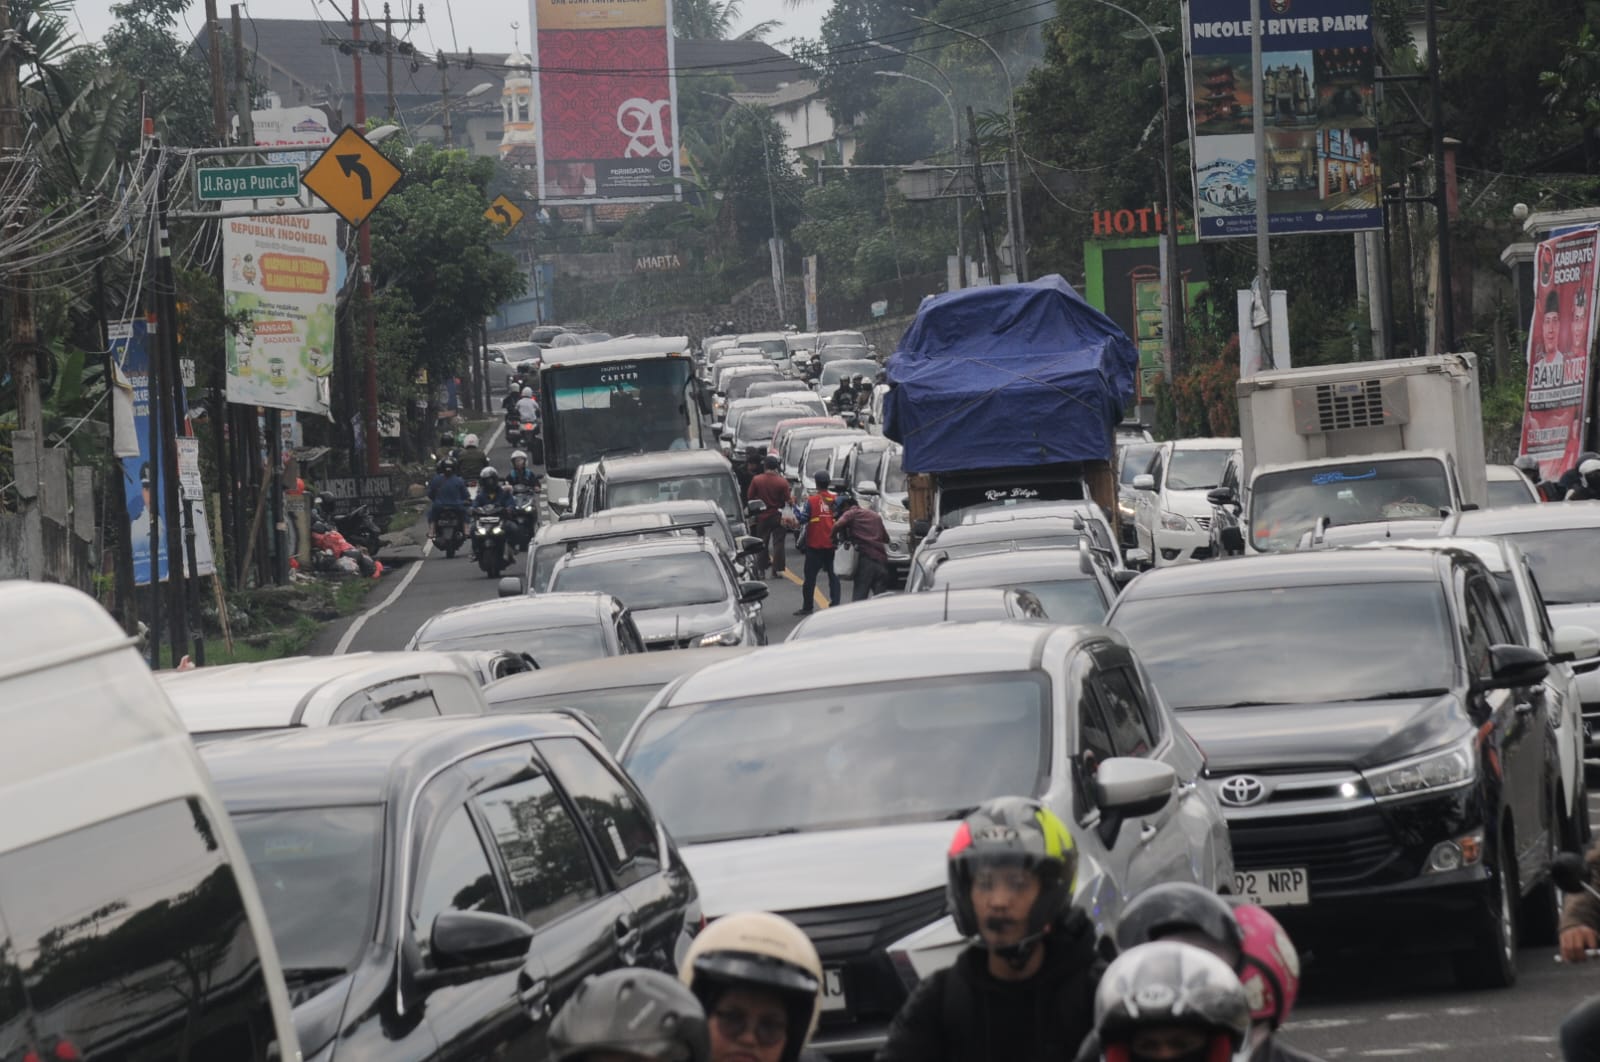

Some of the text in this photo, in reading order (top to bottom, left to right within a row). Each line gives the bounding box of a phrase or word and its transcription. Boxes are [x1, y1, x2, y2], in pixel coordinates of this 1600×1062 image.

[1268, 17, 1319, 35] RIVER
[1322, 14, 1368, 32] PARK
[250, 172, 295, 190] Puncak
[230, 221, 328, 246] REPUBLIK INDONESIA
[635, 254, 681, 271] AMARTA
[1554, 267, 1581, 284] BOGOR
[1533, 363, 1562, 386] BAYU
[1267, 870, 1304, 893] NRP
